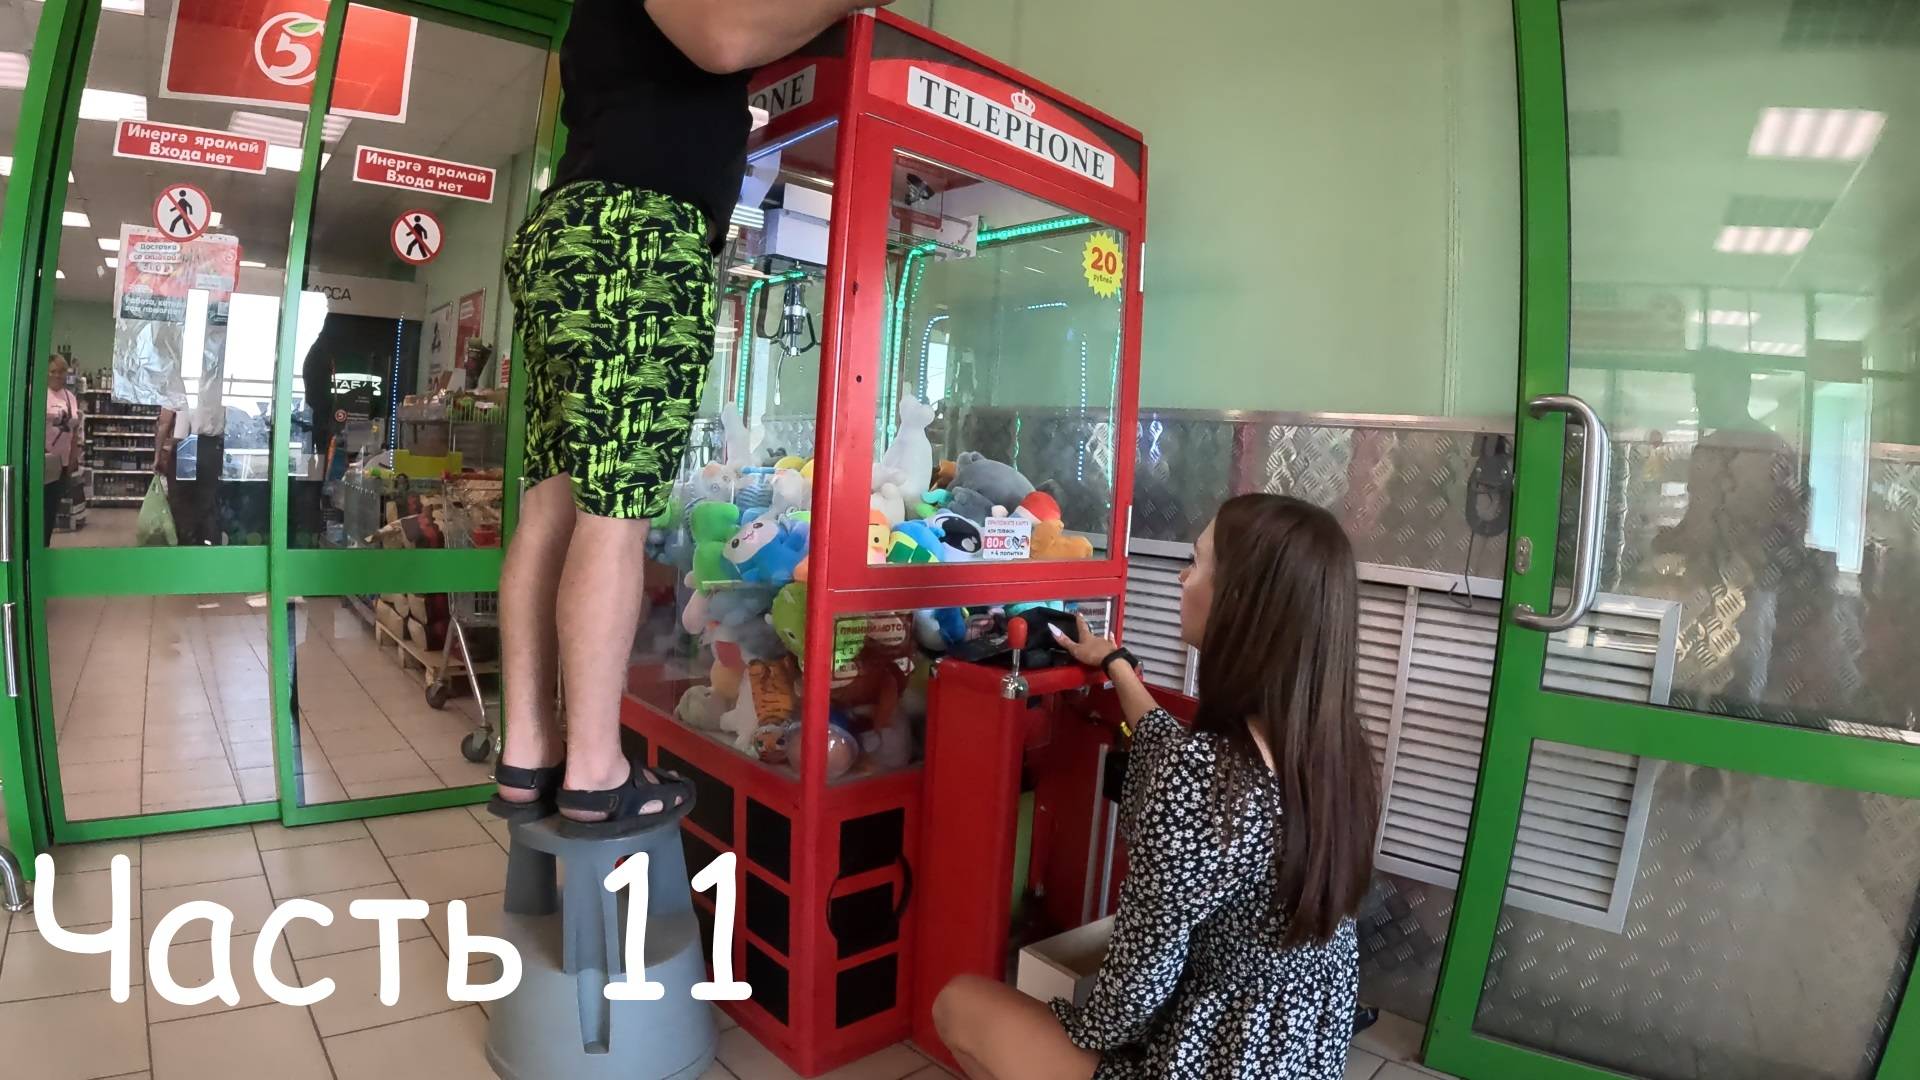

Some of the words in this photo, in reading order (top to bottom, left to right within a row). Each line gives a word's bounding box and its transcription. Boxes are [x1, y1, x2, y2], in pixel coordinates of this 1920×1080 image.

[127, 123, 188, 143] Инергә
[195, 136, 259, 154] ярамай
[919, 75, 1105, 181] TELEPHONE
[149, 142, 201, 161] Входа
[205, 152, 234, 164] нет
[365, 151, 422, 172] Инергә
[428, 164, 486, 184] ярамай
[386, 169, 434, 189] Входа
[438, 180, 463, 193] нет
[1091, 246, 1117, 275] 20
